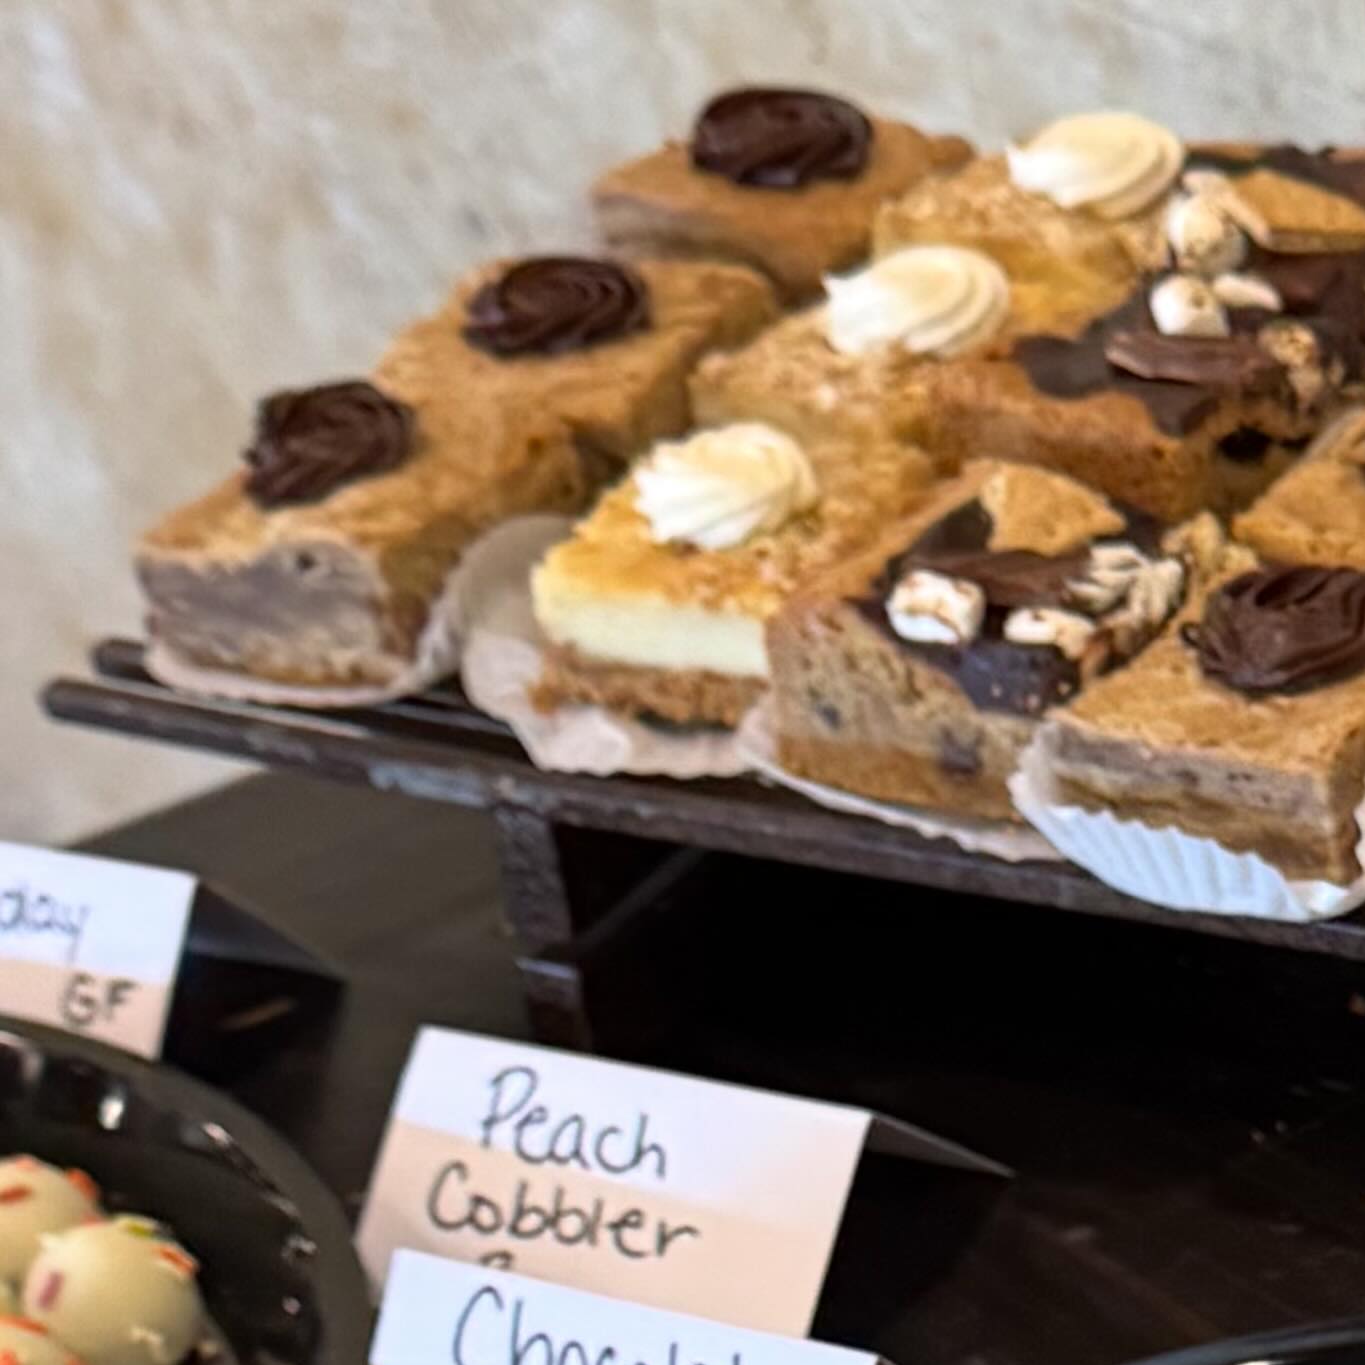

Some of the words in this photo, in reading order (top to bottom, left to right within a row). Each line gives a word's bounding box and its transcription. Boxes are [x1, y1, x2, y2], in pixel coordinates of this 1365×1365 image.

[60, 971, 141, 1026] GF
[480, 1066, 667, 1179] Peach
[426, 1160, 701, 1260] Cobbler
